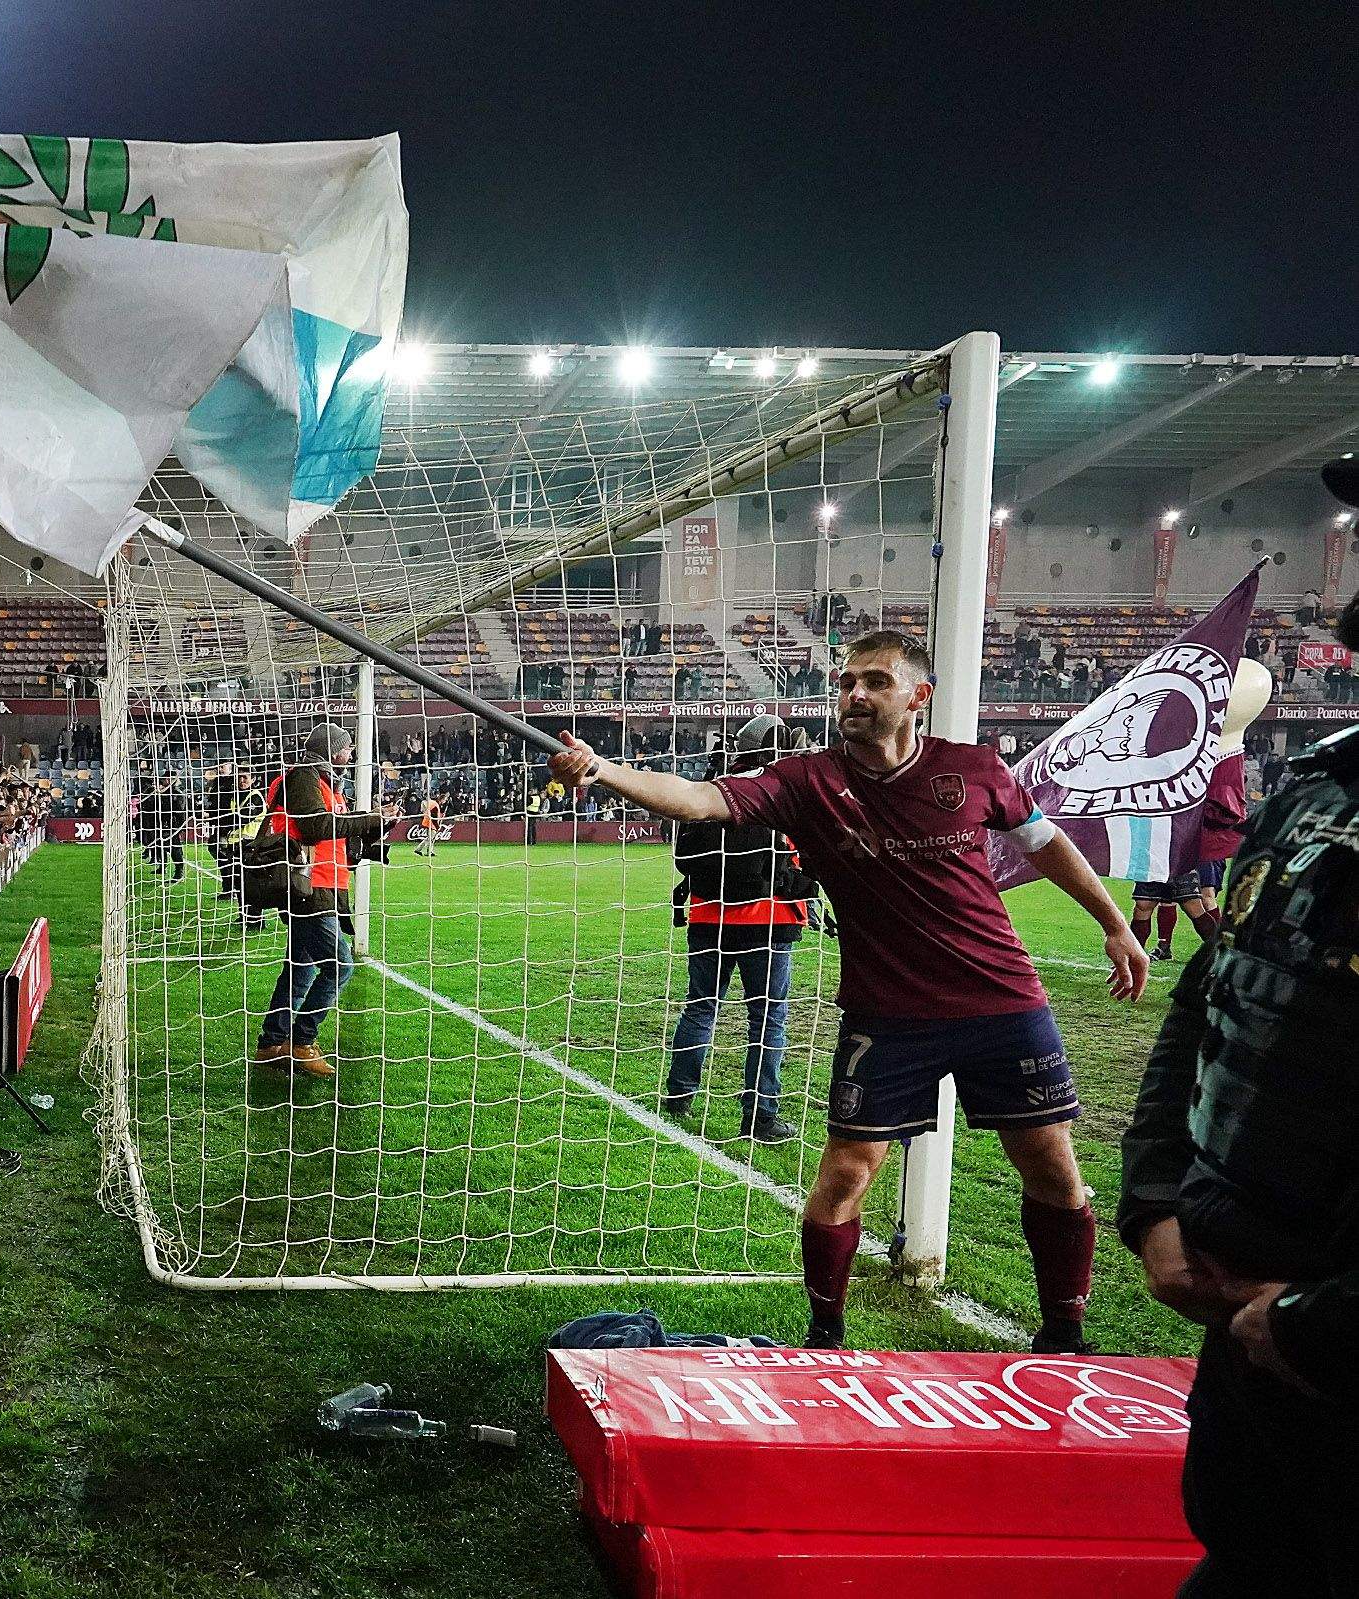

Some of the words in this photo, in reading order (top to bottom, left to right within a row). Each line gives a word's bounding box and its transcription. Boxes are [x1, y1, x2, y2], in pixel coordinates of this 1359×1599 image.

[685, 524, 709, 534] FOR
[685, 535, 700, 544] ZA
[684, 556, 714, 565] TEVE
[684, 566, 708, 575] DRA
[298, 702, 325, 713] IDC
[669, 703, 711, 716] Estrella
[713, 703, 751, 716] Galicia
[790, 703, 833, 717] Estrella
[1276, 706, 1308, 719] Diario
[1044, 710, 1069, 718] HOTEL
[849, 1034, 874, 1077] 7
[1037, 1052, 1060, 1065] XUNTA
[1038, 1062, 1049, 1071] DE
[700, 1351, 886, 1371] MAPFRE
[647, 1376, 800, 1427] REY
[783, 1397, 840, 1409] DEL
[818, 1376, 1052, 1431] COPA
